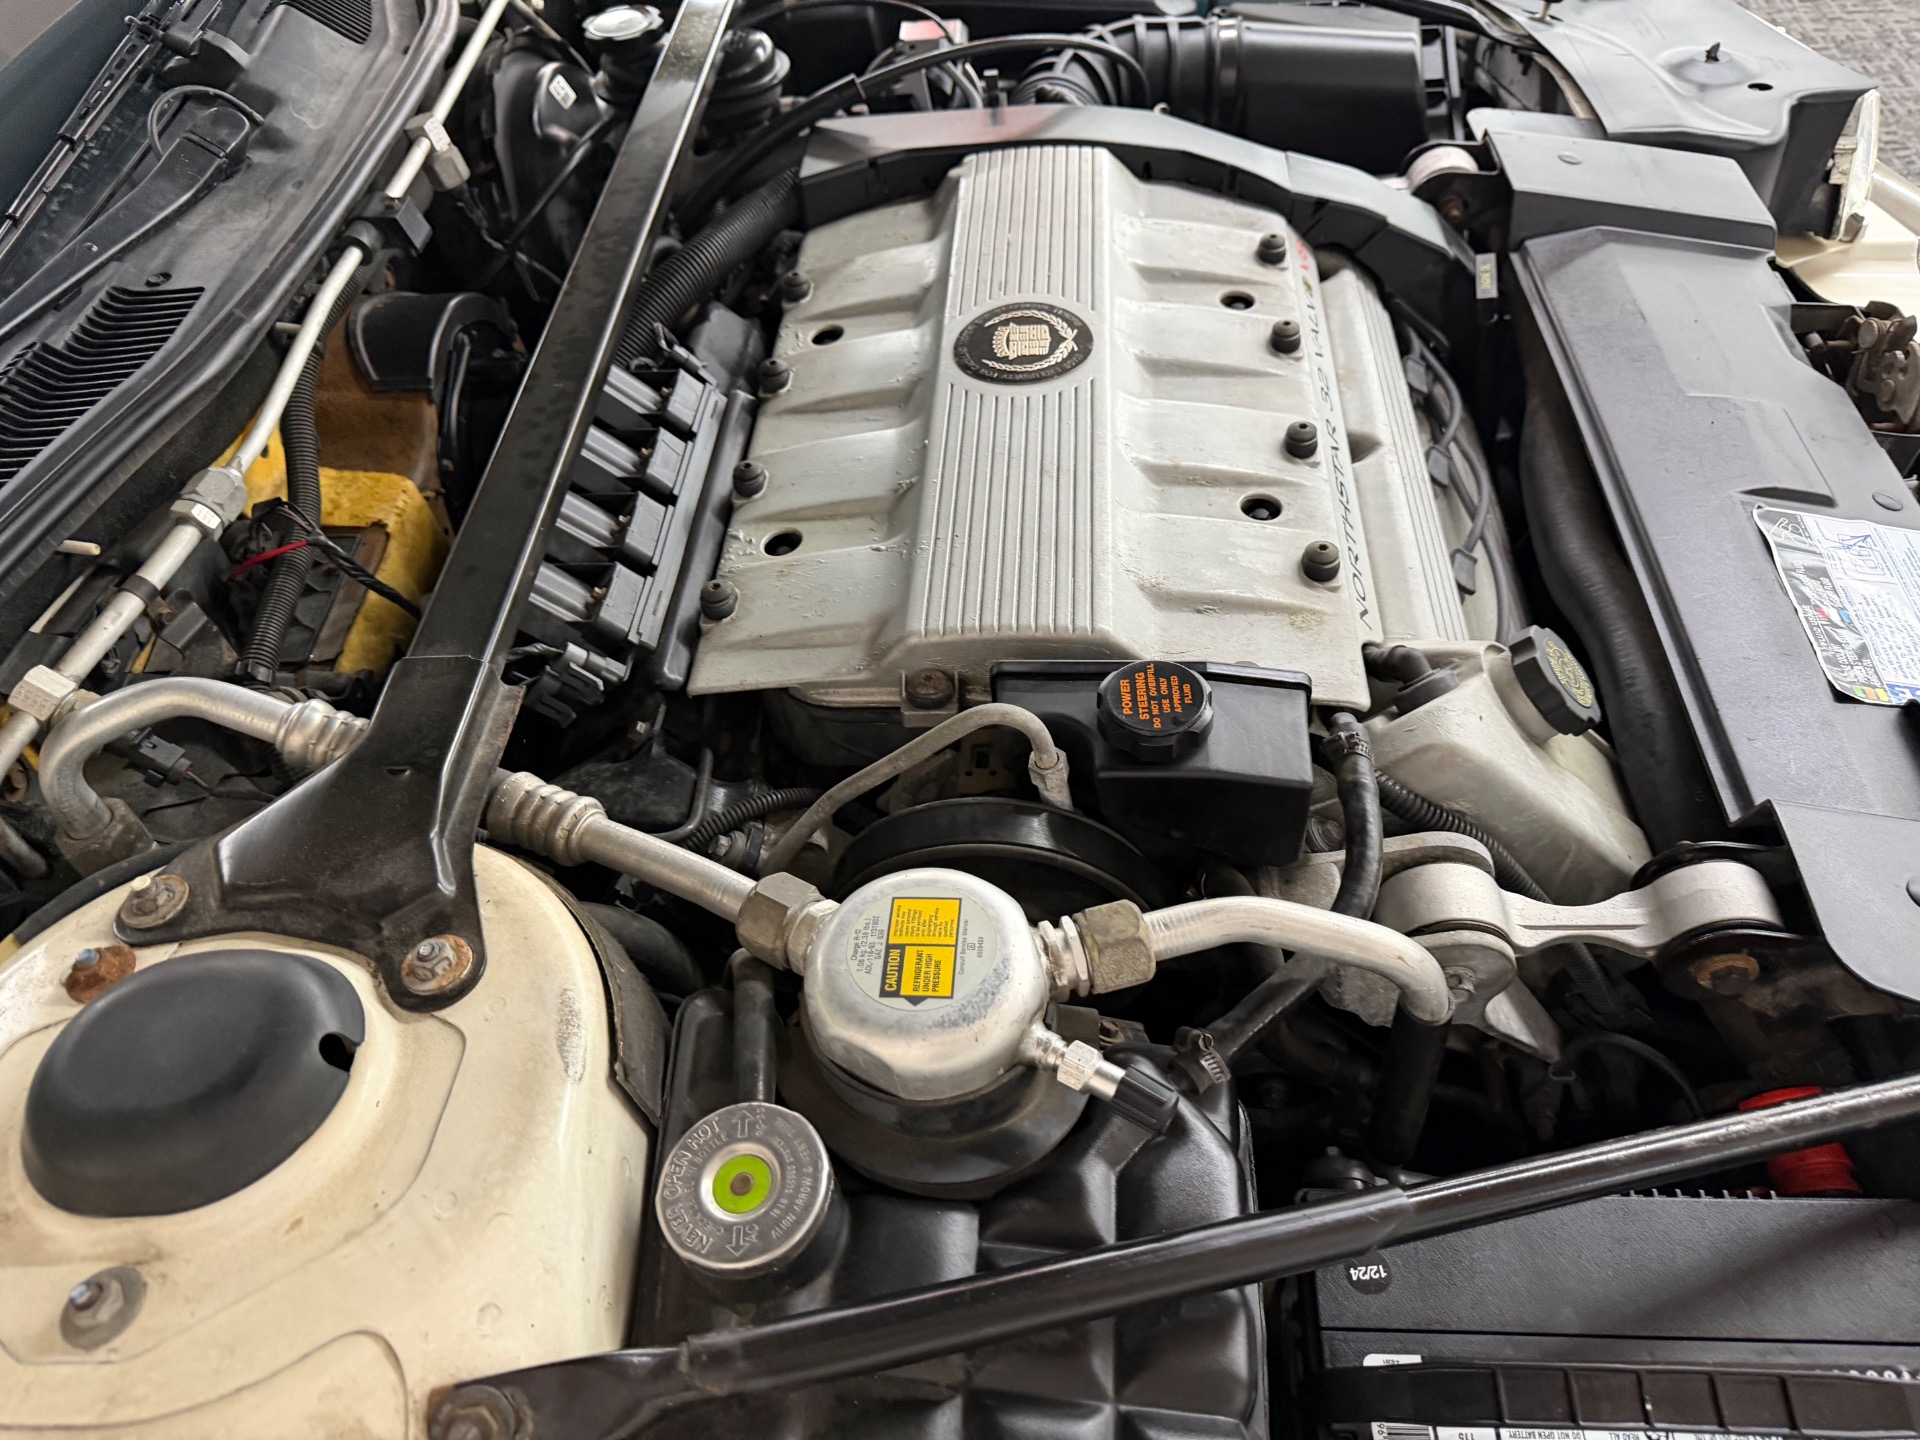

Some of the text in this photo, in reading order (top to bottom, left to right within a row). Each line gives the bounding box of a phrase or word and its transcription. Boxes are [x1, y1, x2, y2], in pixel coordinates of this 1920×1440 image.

[1318, 367, 1333, 412] 32
[1325, 418, 1372, 631] NORTHSTAR
[1120, 679, 1133, 715] POWER
[1135, 672, 1150, 720] STEERING
[1147, 663, 1162, 729] DO NOT OVERFILL
[1159, 678, 1171, 713] USE ONLY
[1171, 676, 1183, 713] APPROVED
[1183, 683, 1193, 704] FLUID
[884, 949, 901, 992] CAUTION
[912, 949, 925, 993] REFRIGERANT
[922, 953, 933, 993] UNDER HIGH
[931, 959, 942, 993] PRESSURE
[663, 1116, 720, 1254] NEVER OPEN HOT
[771, 1213, 797, 1240] ALIGN
[793, 1177, 814, 1215] ARROW
[745, 1223, 760, 1244] AC
[1349, 1264, 1388, 1281] 12/24
[1539, 1431, 1556, 1440] OPEN
[1556, 1431, 1570, 1440] NOT
[1572, 1431, 1581, 1440] DO
